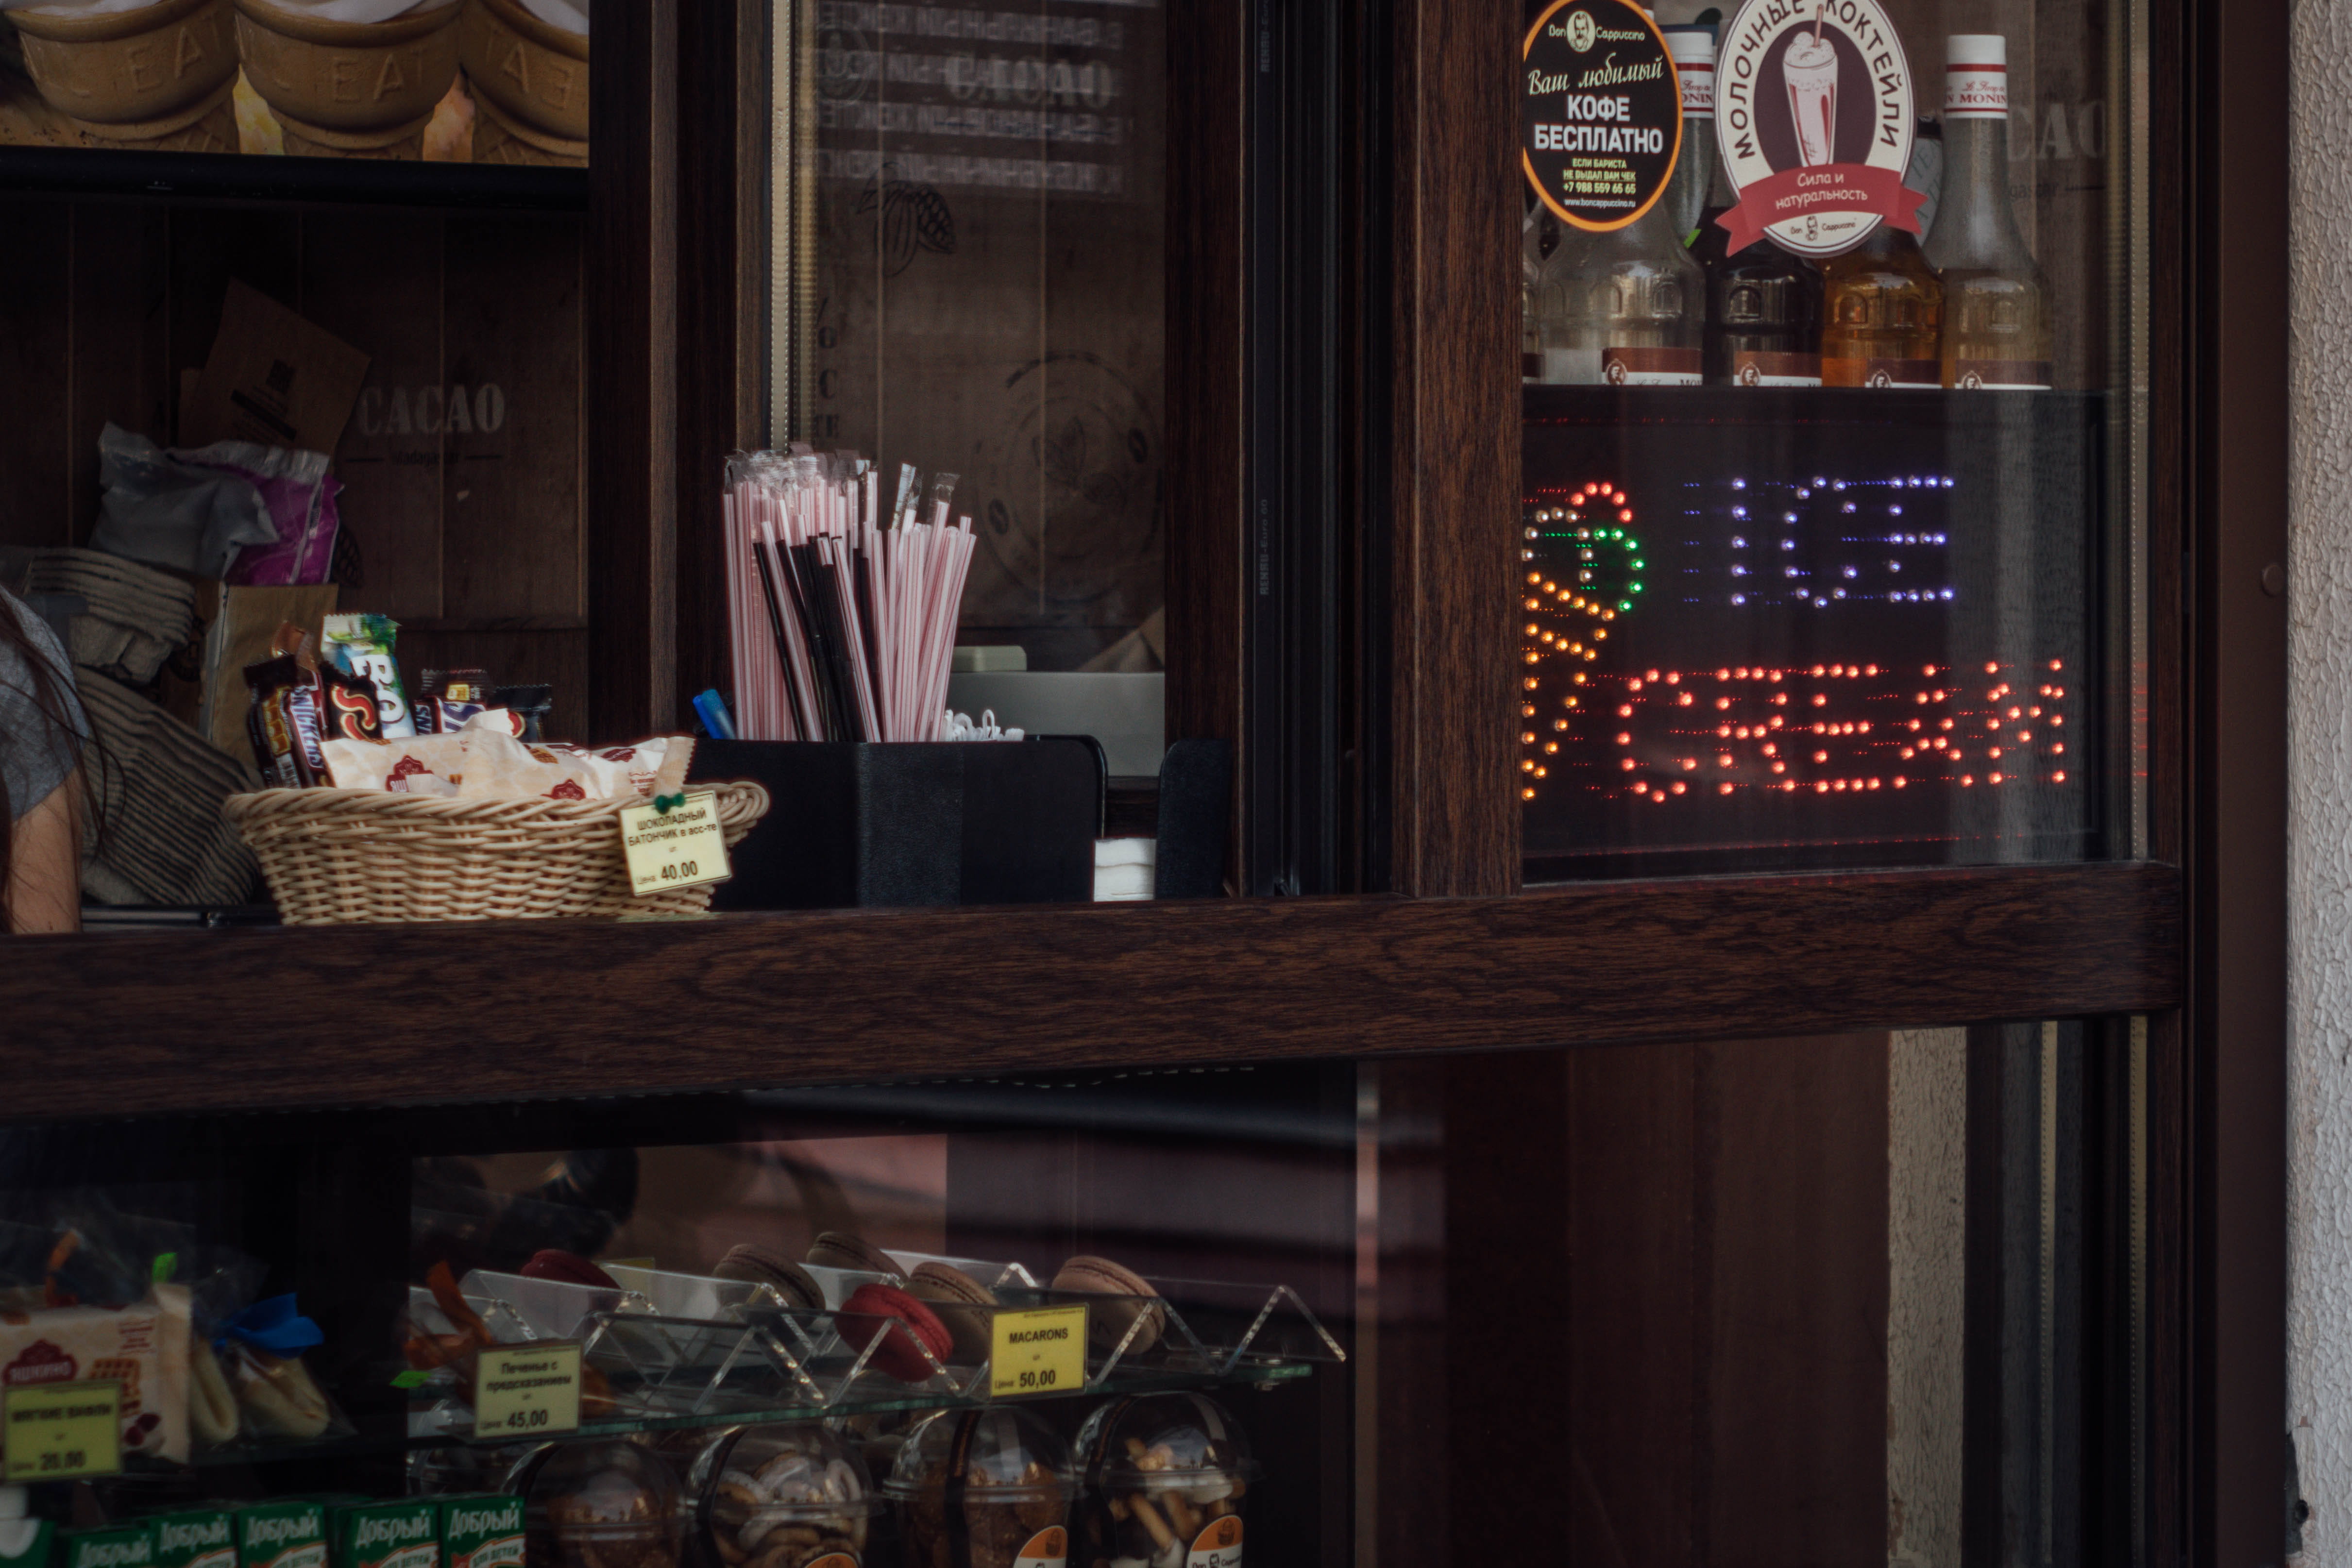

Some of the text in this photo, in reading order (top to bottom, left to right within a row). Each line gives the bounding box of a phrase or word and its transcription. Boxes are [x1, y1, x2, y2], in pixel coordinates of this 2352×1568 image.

[1596, 26, 1645, 42] Cappuccino
[1528, 52, 1664, 95] Ваш любимый
[1730, 0, 1902, 159] МОЛОЧНЫЕ КОКТЕЙЛИ
[1568, 94, 1631, 122] КОФЕ
[1959, 94, 2007, 103] MONIN
[1534, 123, 1664, 153] БЕСПЛАТНО
[1572, 158, 1627, 169] ЕСЛИ БАРИСТА
[1563, 169, 1574, 180] НЕ
[1621, 171, 1636, 182] ЧЕК
[1797, 173, 1844, 187] Сила и
[1562, 181, 1574, 193] +7
[1593, 183, 1611, 194] 559
[1612, 183, 1624, 194] 65
[1624, 184, 1636, 195] 65
[1775, 189, 1868, 210] натуральность
[356, 382, 505, 436] CACAO
[1731, 475, 1954, 609] ICE
[1616, 658, 2067, 804] CREAM
[637, 808, 707, 831] ШОКОЛАДНЫЙ
[628, 824, 717, 846] БАТОНЧИК в асс-те
[660, 860, 698, 881] 40,00
[1009, 1328, 1068, 1345] MACARONS
[502, 1362, 548, 1375] Печенье
[1020, 1369, 1056, 1389] 50,00
[508, 1410, 548, 1429] 45,00
